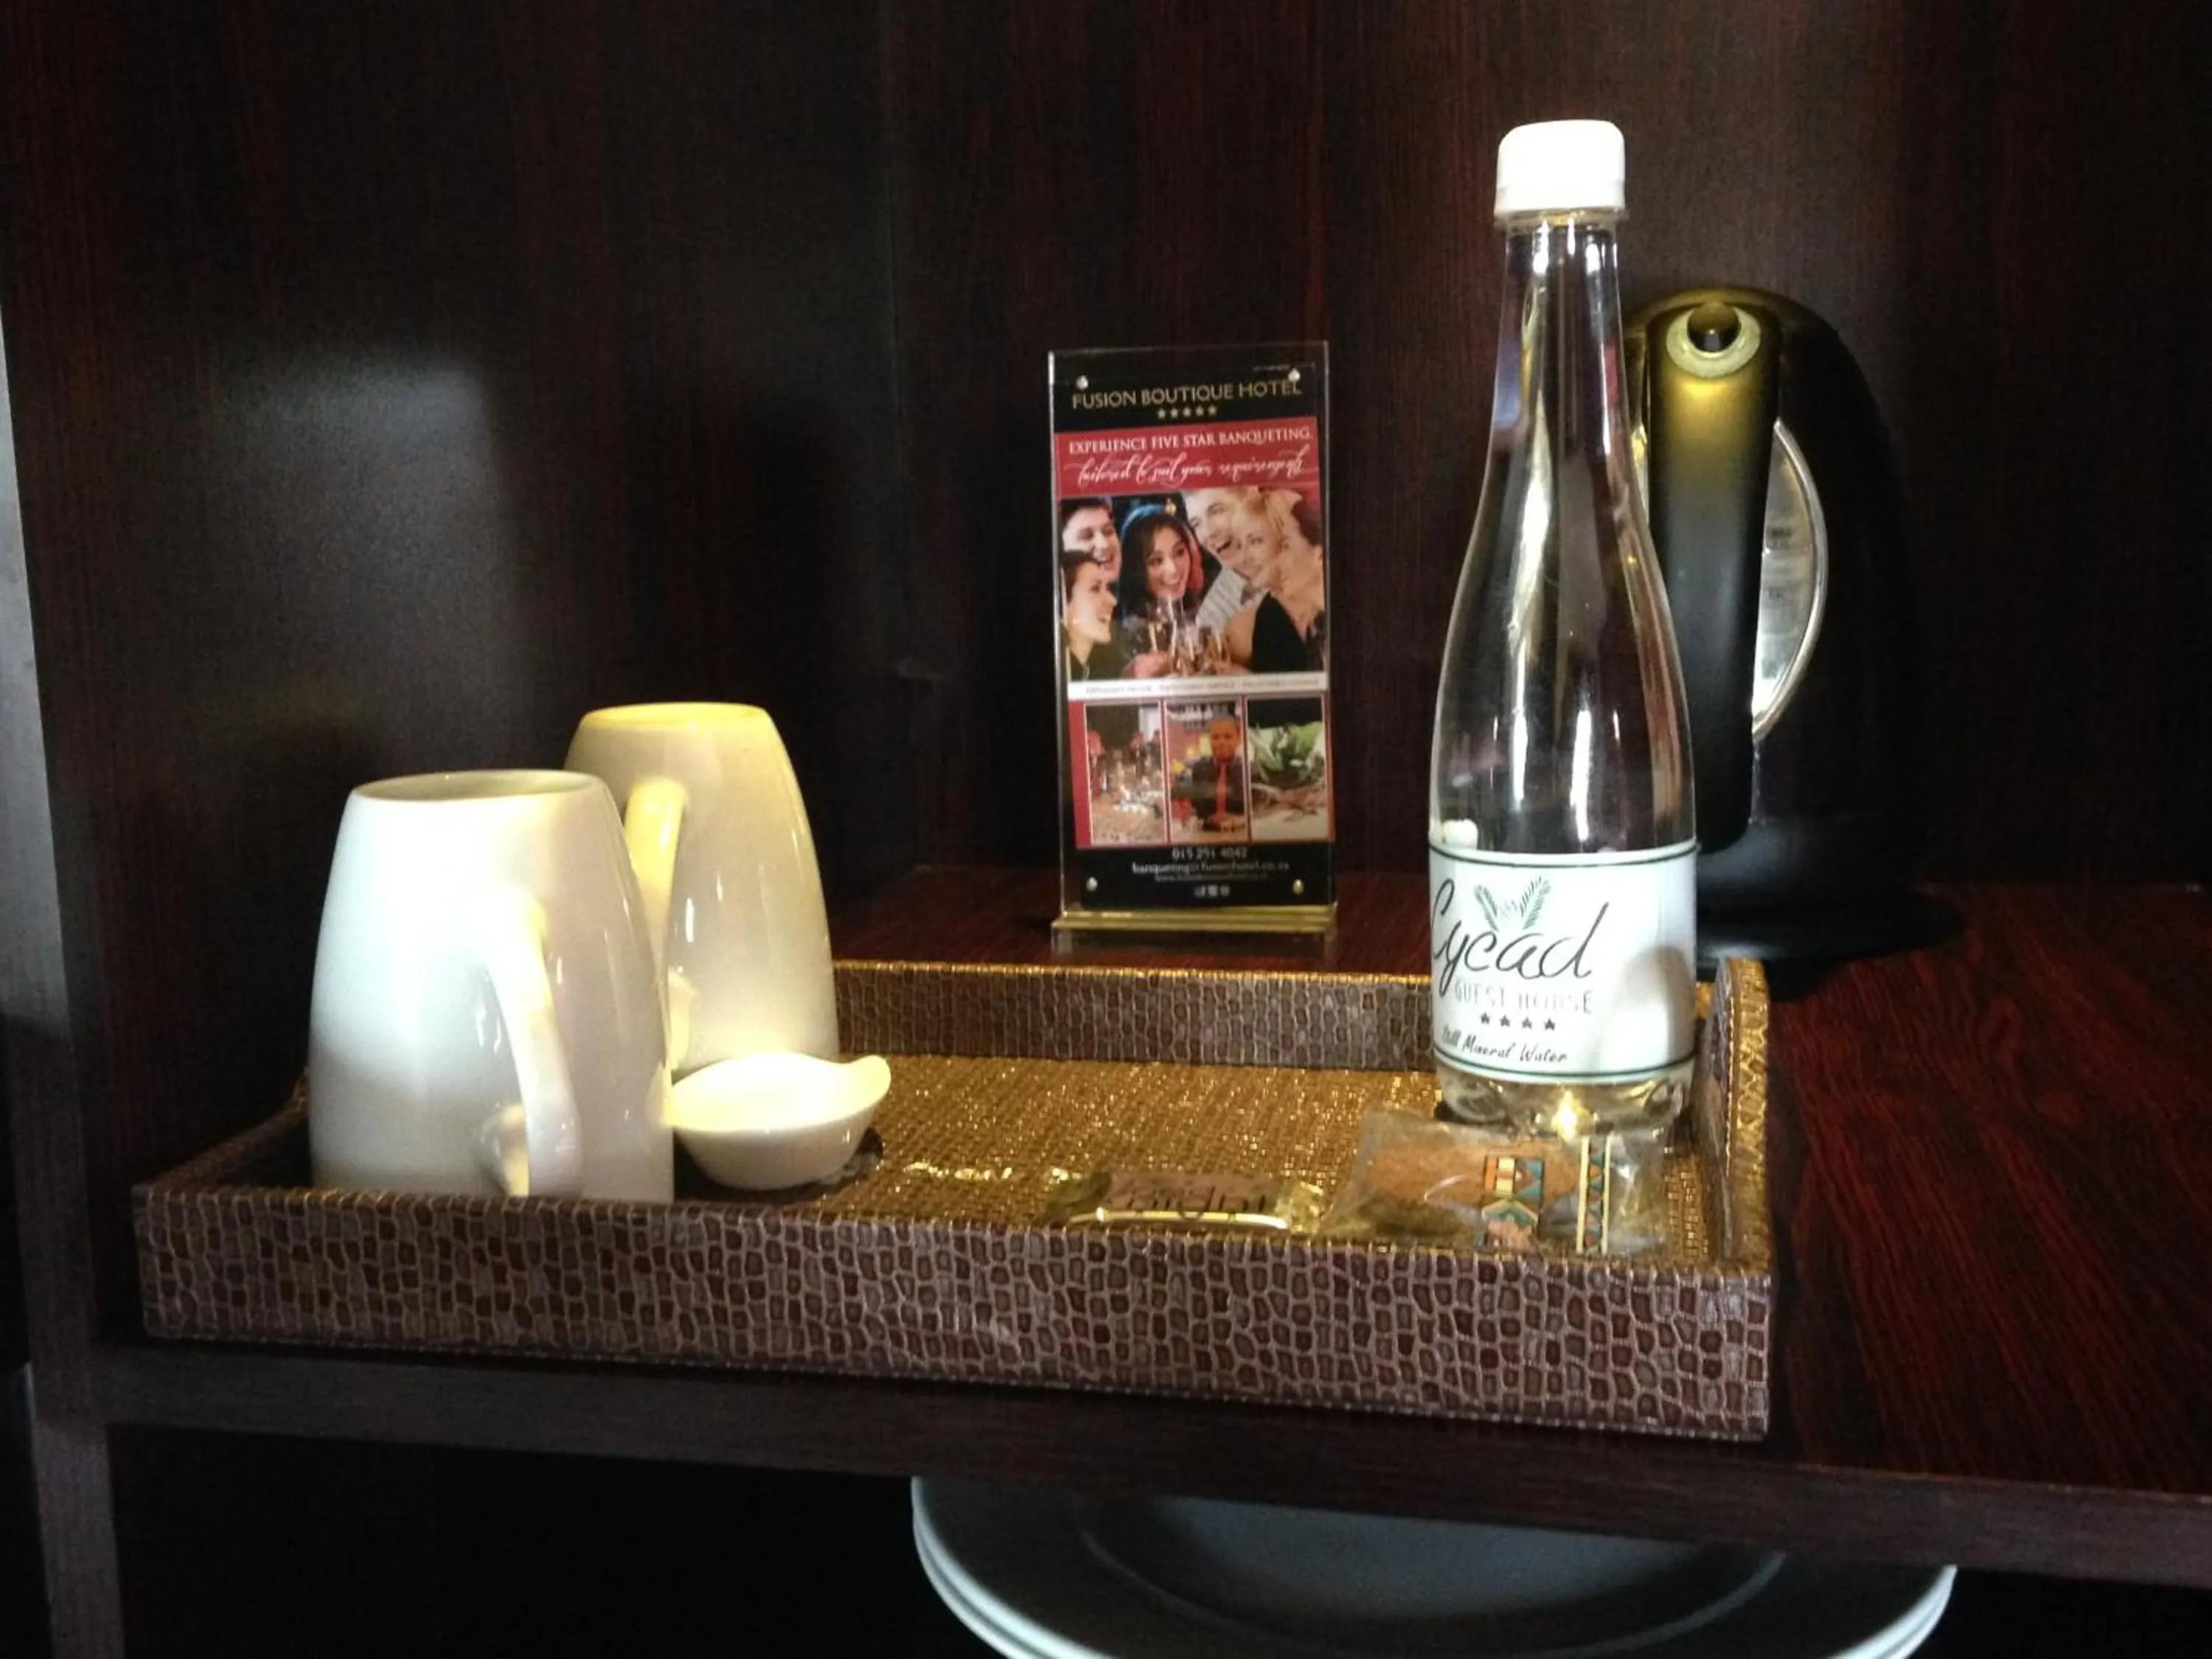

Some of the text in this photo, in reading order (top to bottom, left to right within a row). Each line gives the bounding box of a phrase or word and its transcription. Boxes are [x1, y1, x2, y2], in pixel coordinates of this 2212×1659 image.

[1072, 378, 1302, 409] FUSION BOUTIQUE HOTEL
[1069, 426, 1310, 455] EXPERIENCE FIVE STAR BANQUETING
[1431, 877, 1610, 997] Cycad
[1454, 978, 1506, 1008] GUEST
[1462, 1034, 1517, 1058] Mineral
[1520, 1043, 1568, 1062] Water
